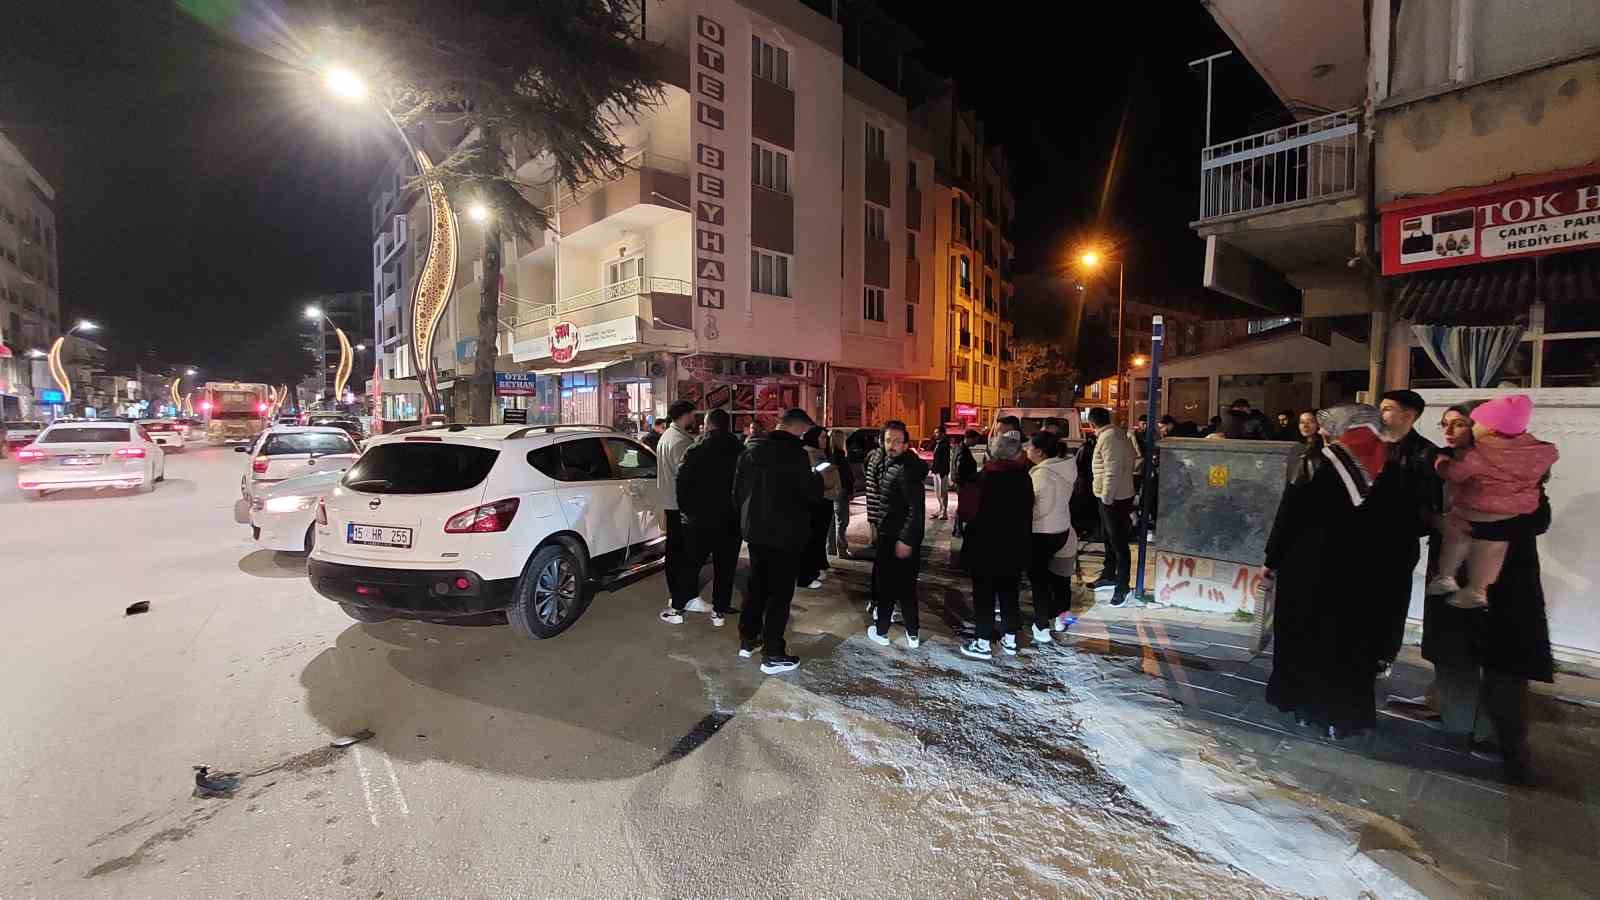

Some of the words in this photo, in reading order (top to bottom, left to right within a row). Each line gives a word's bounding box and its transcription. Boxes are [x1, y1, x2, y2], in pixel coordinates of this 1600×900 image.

[701, 17, 722, 127] OTEL
[1478, 192, 1565, 226] TOK
[702, 145, 721, 307] BEYHAN
[1499, 223, 1549, 239] ÇANTA
[1507, 230, 1589, 250] HEDİYELİK
[500, 380, 536, 389] BEYHAN
[504, 373, 529, 381] OTEL
[354, 526, 364, 540] 15
[371, 527, 384, 541] HR
[391, 529, 408, 544] 255
